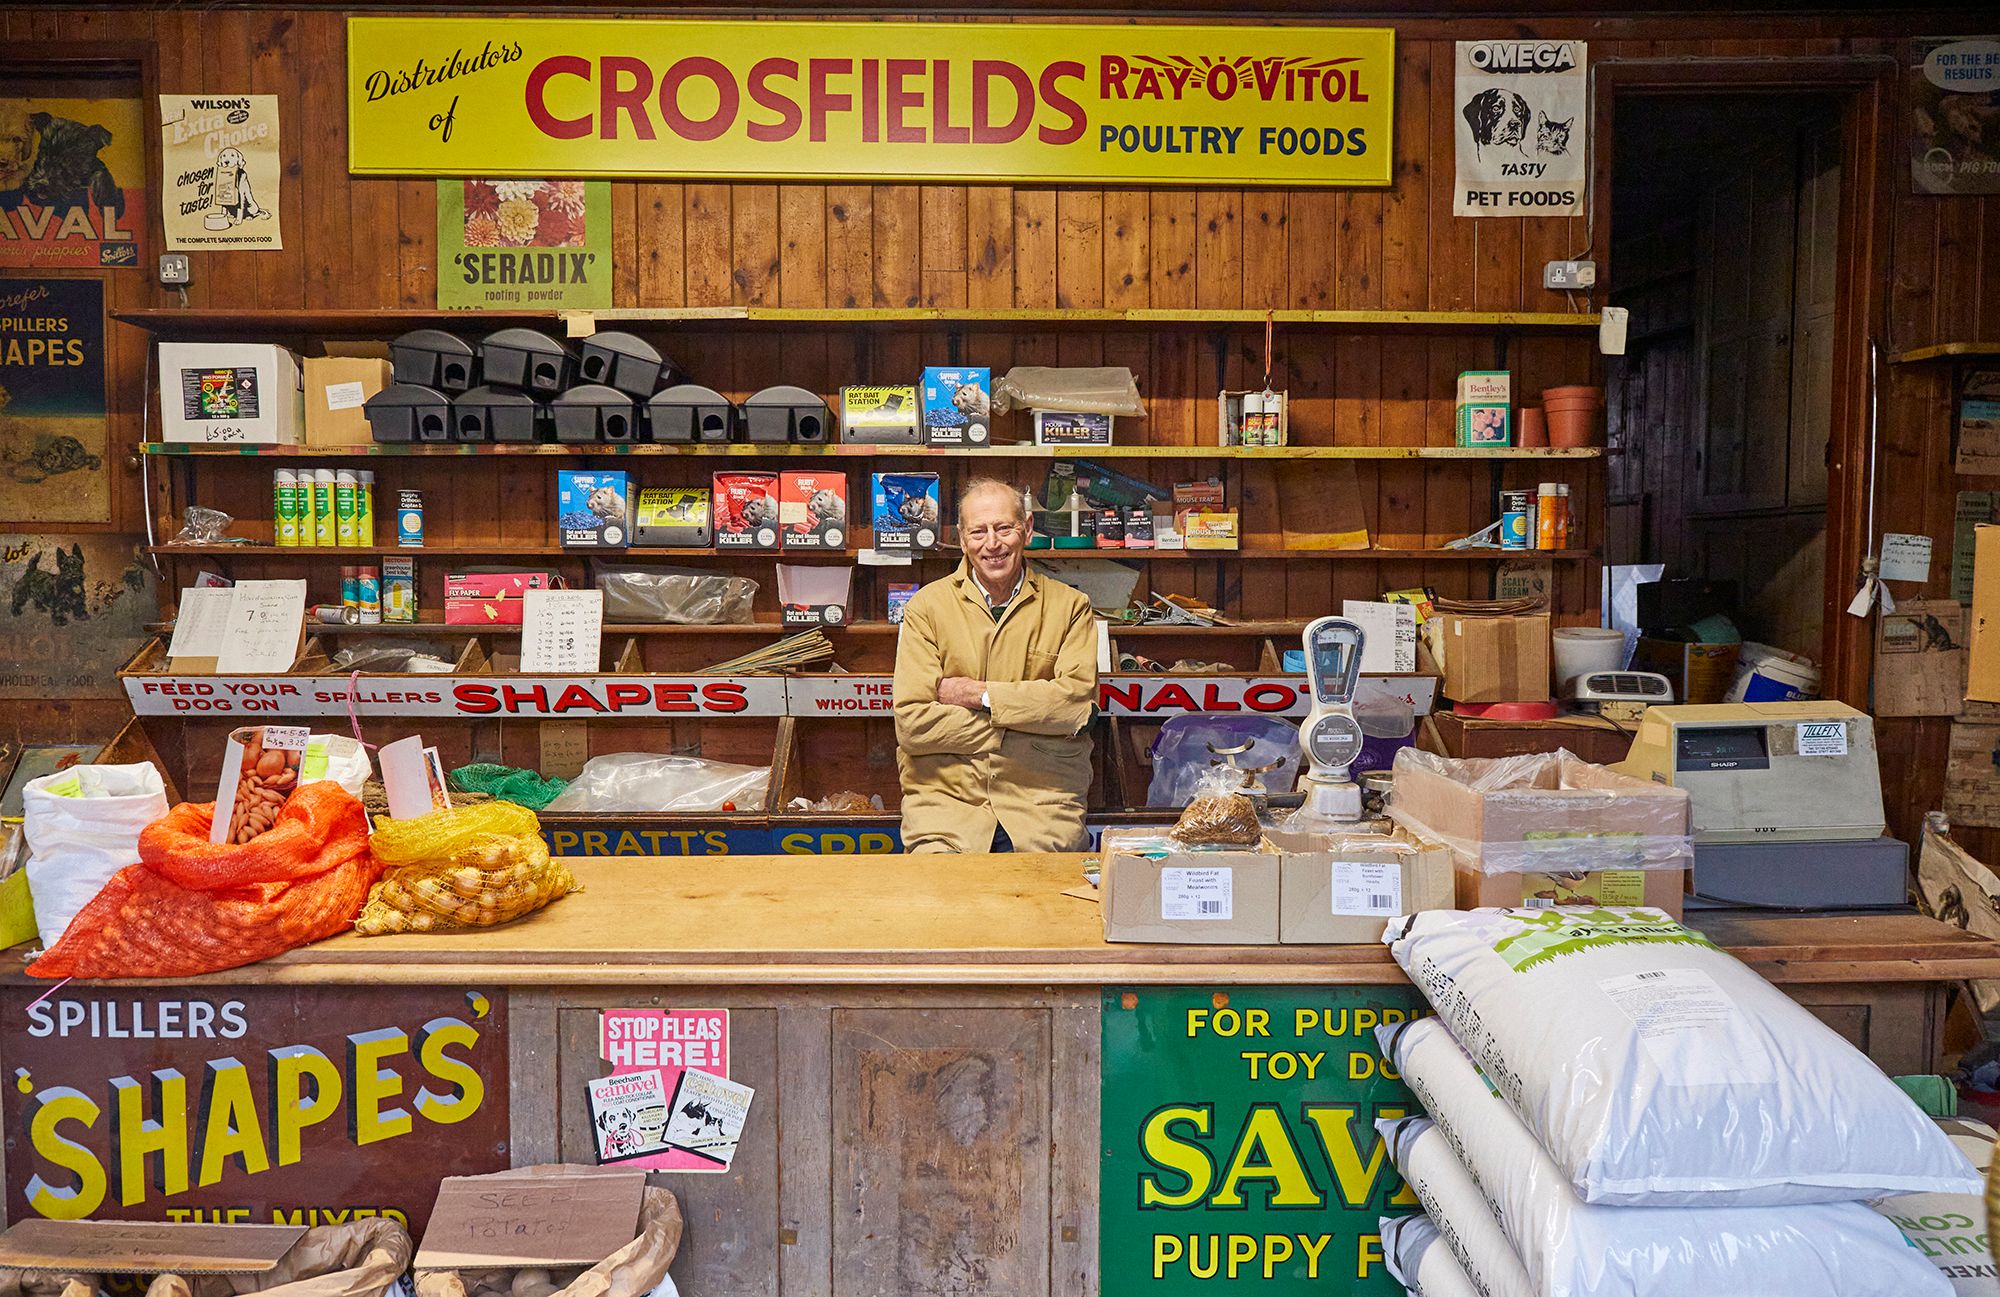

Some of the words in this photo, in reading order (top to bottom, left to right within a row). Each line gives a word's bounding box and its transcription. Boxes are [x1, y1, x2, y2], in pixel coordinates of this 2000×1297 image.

[1468, 43, 1576, 73] OMEGA
[1936, 54, 1957, 66] FOR
[1962, 54, 1981, 65] THE
[364, 40, 523, 102] Distributors
[191, 98, 251, 110] WILSON'S
[525, 55, 1088, 145] CROSFIELDS
[428, 96, 459, 143] of
[203, 122, 269, 160] Choice
[1101, 125, 1244, 154] POULTRY
[1259, 127, 1368, 157] FOODS
[176, 166, 215, 188] chosen
[1501, 163, 1548, 178] TASTY
[198, 181, 215, 197] for
[1466, 191, 1502, 207] PET
[1508, 191, 1576, 207] FOODS
[179, 193, 214, 216] taste!
[454, 253, 596, 285] 'SERADIX'
[485, 289, 521, 303] rooting
[527, 289, 564, 302] powder
[0, 318, 69, 332] PILLERS
[1470, 384, 1507, 394] Bentley's
[1045, 427, 1090, 436] KILLER
[730, 487, 747, 495] RUBY
[142, 683, 214, 696] FEED
[222, 683, 302, 696] YOUR
[452, 683, 749, 714] SHAPES
[853, 683, 893, 695] THE
[173, 698, 231, 711] DOG
[242, 699, 280, 711] ON
[1803, 724, 1842, 738] TILLFIX
[26, 1000, 249, 1039] SPILLERS
[608, 1017, 659, 1040] STOP
[662, 1017, 722, 1040] FLEAS
[1187, 1007, 1272, 1038] FOR
[608, 1041, 721, 1067] HERE!
[1241, 1051, 1326, 1080] TOY
[595, 1074, 657, 1099] canovel
[608, 1075, 642, 1086] Beecham
[13, 991, 490, 1220] 'SHAPES'
[481, 1192, 573, 1210] SEED
[1153, 1233, 1333, 1280] PUPPY
